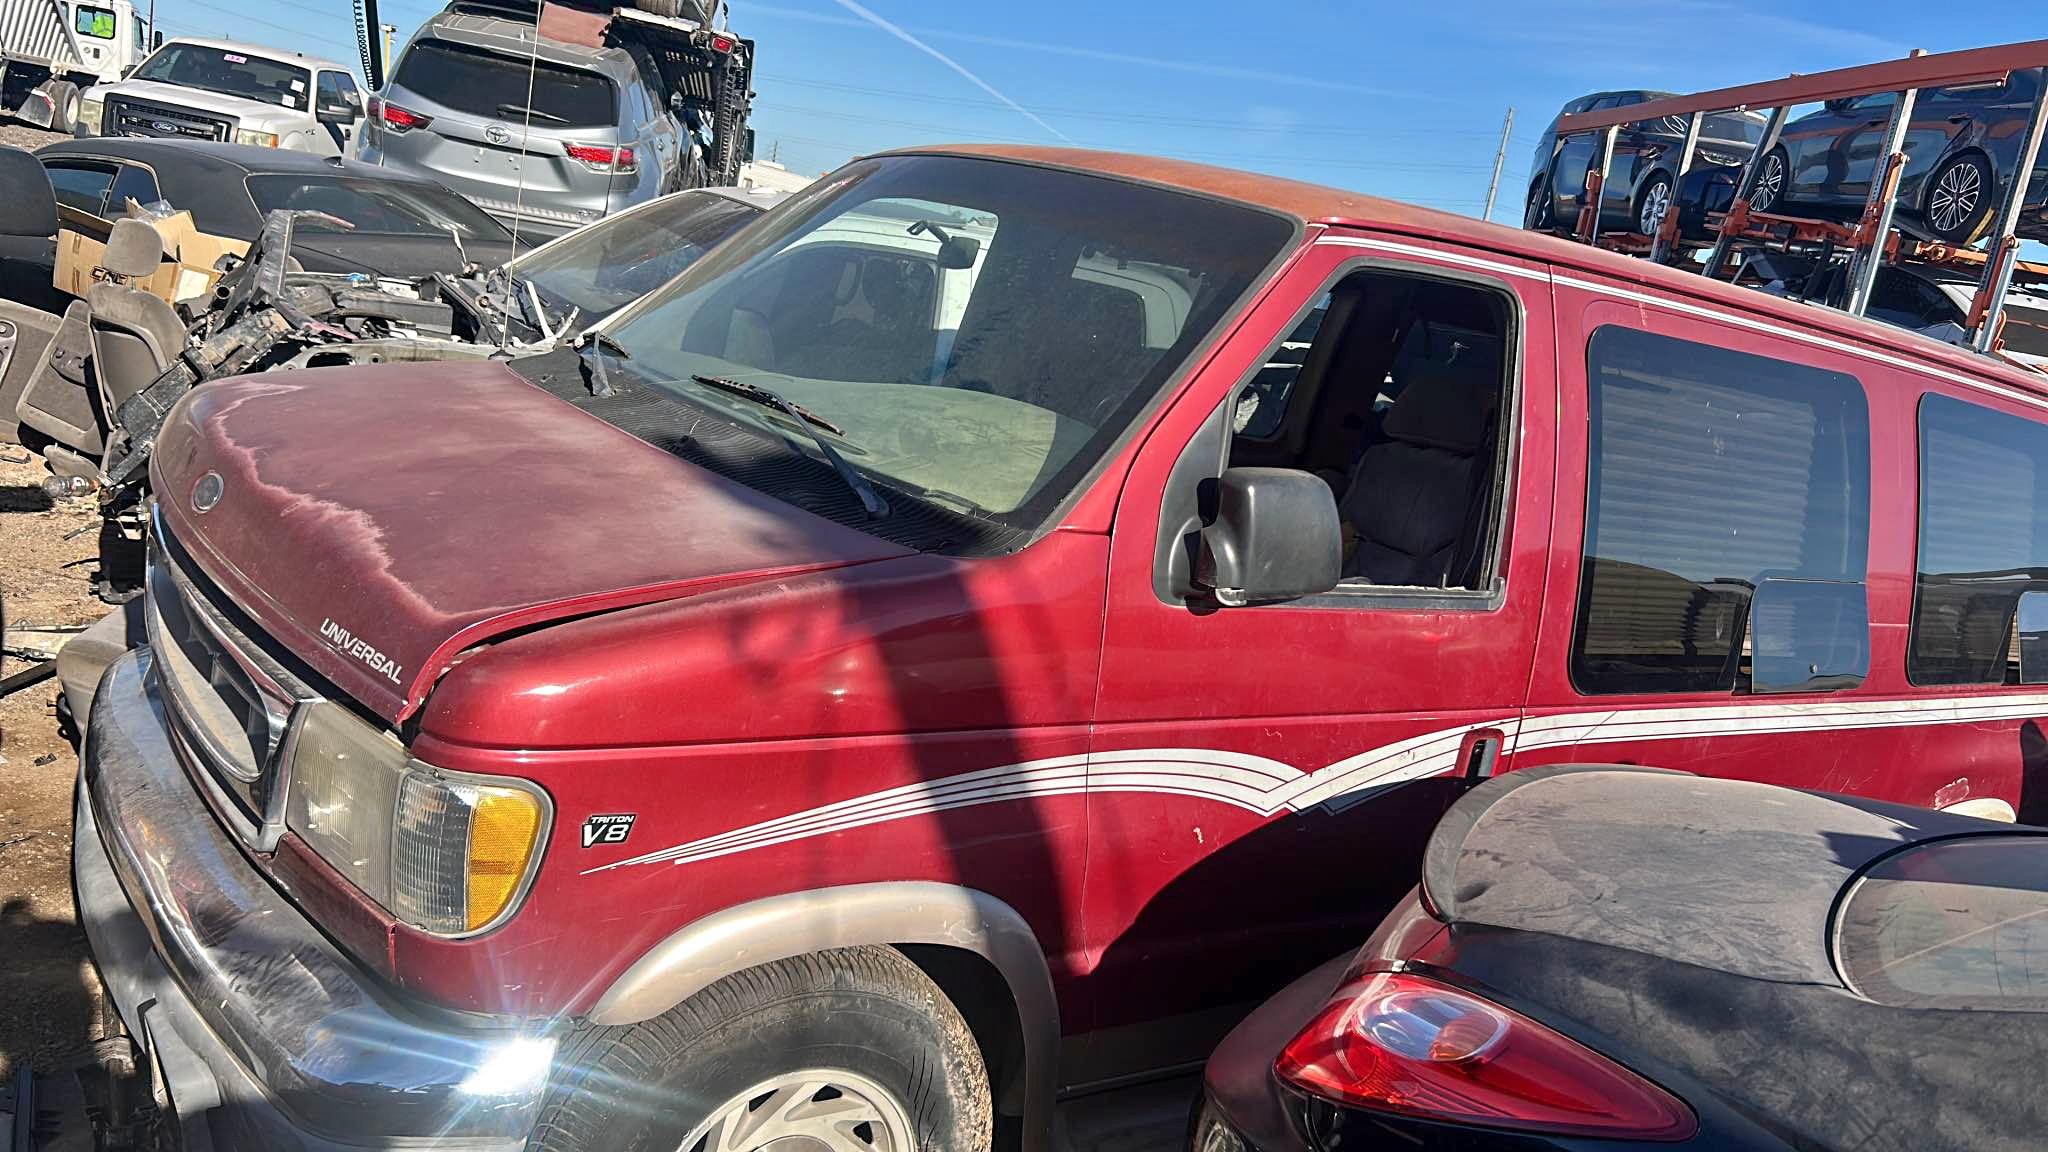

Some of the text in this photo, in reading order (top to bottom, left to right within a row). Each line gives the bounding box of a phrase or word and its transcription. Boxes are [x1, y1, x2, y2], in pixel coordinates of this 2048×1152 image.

[320, 617, 402, 686] UNIVERSAL
[591, 815, 635, 824] TRITON
[584, 824, 630, 847] V8
